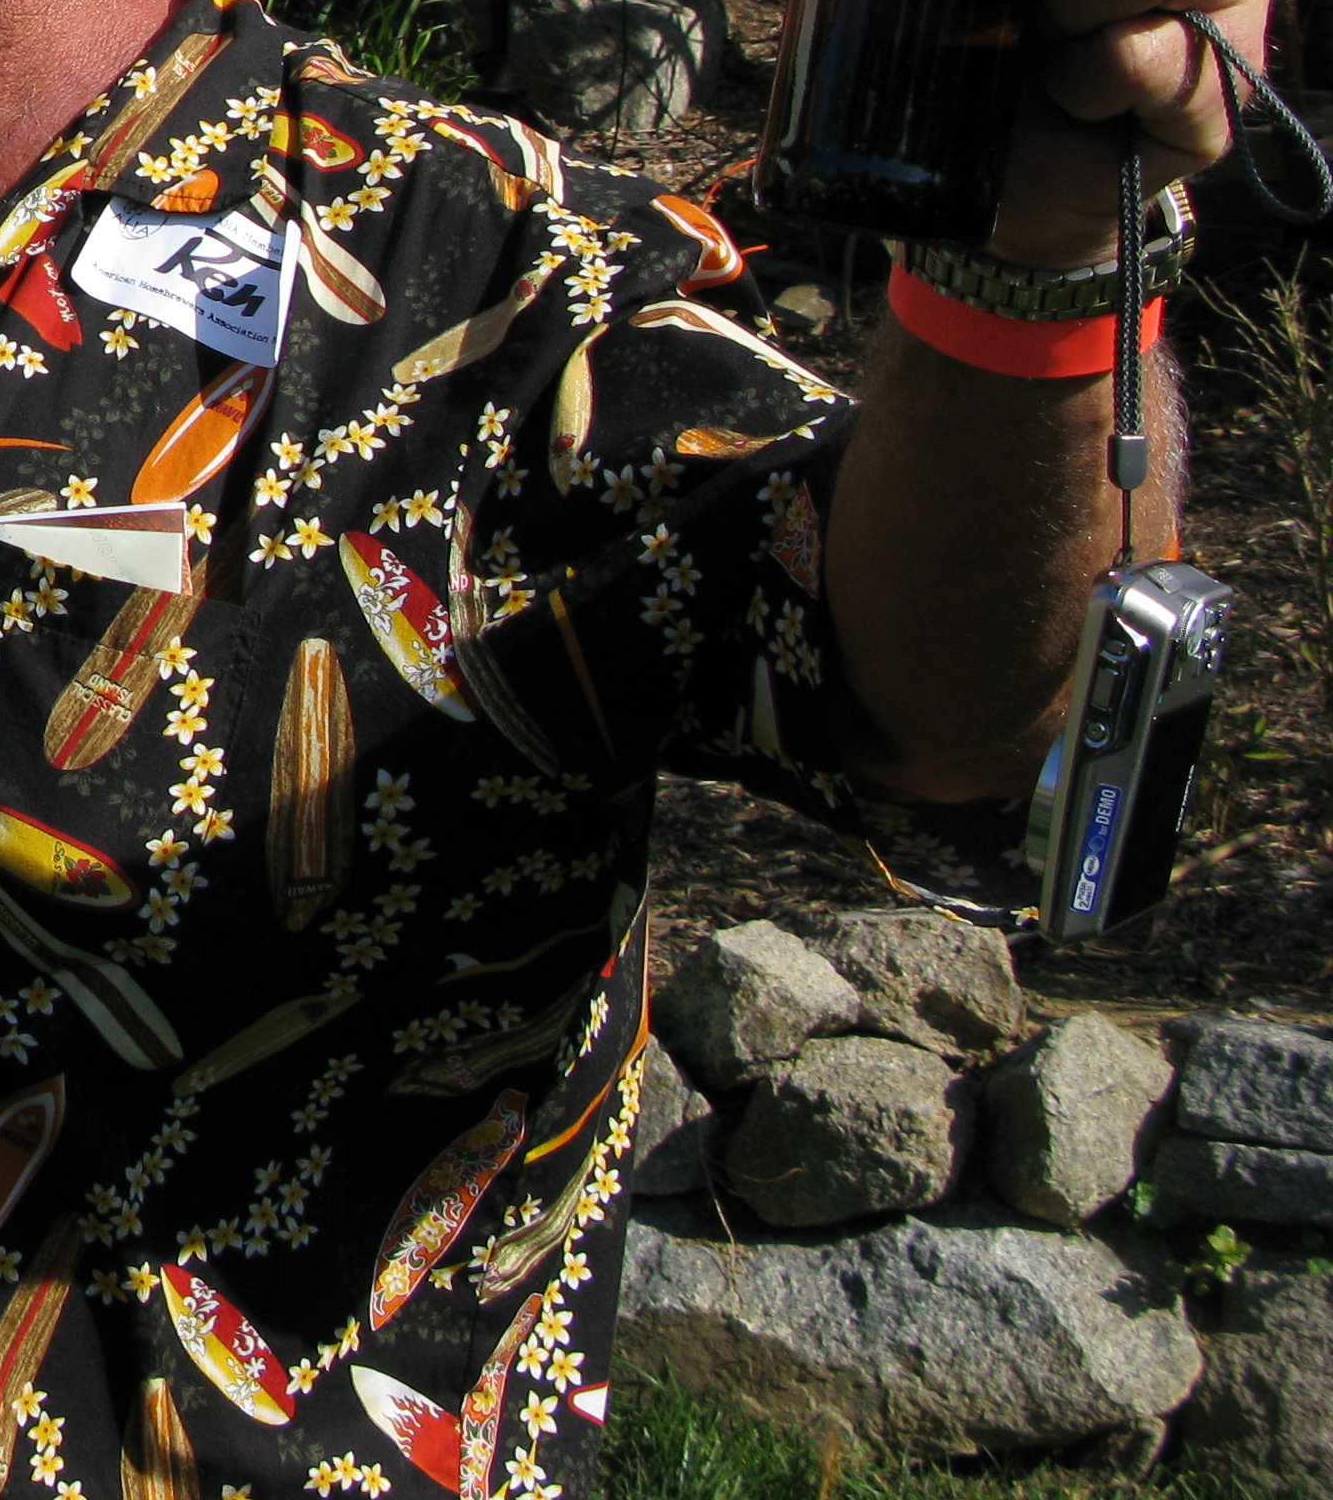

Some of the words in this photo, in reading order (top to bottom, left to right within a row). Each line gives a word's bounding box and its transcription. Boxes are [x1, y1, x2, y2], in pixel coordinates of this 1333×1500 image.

[113, 212, 150, 238] AHA
[242, 231, 283, 257] Membe
[153, 236, 266, 317] Ken
[139, 279, 205, 316] Homebrewers
[206, 312, 269, 343] Association
[73, 681, 132, 722] CLASSICAL
[89, 673, 134, 706] ISLAND
[1095, 789, 1116, 825] DEMO
[287, 882, 333, 897] HAWAII
